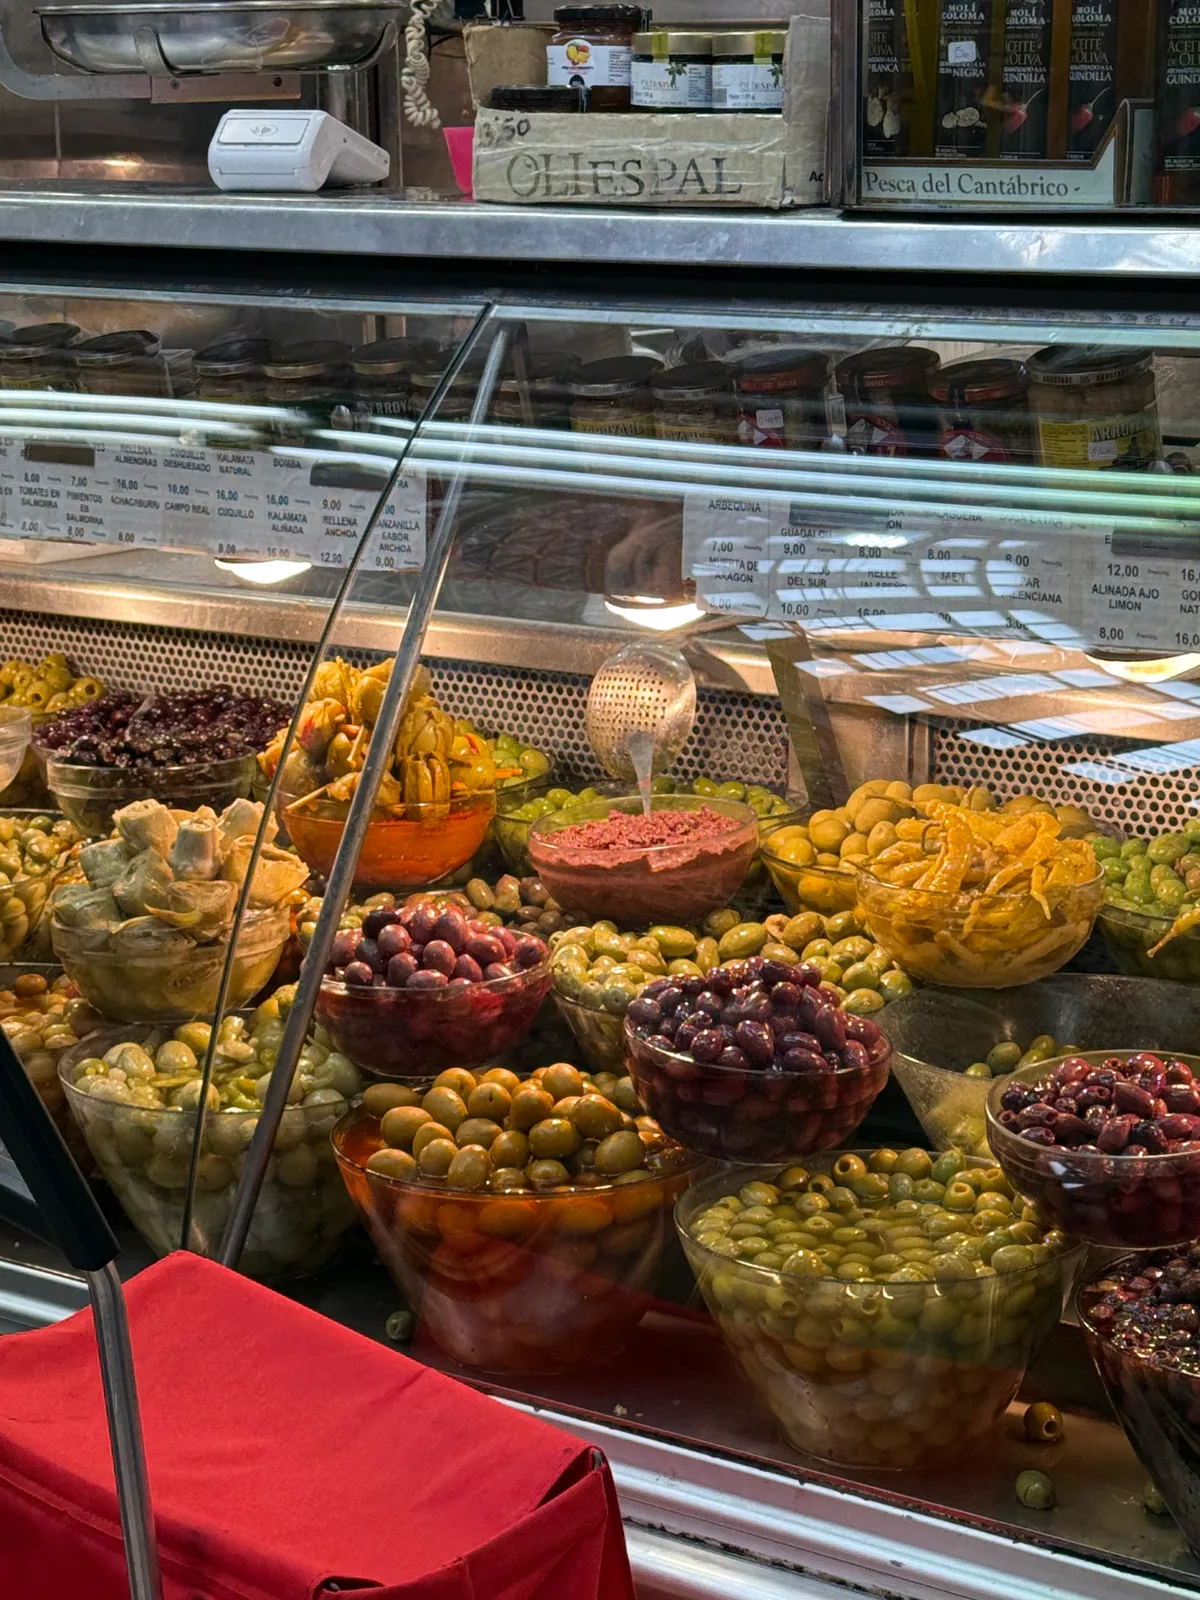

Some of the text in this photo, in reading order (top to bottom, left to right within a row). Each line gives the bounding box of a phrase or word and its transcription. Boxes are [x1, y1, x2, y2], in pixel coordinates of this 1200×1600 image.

[942, 12, 985, 20] COLOMA
[1009, 52, 1043, 65] OLIVA
[1075, 51, 1109, 63] OLIVA
[952, 68, 984, 77] NEGRA
[1003, 73, 1045, 83] GUINDILLA
[1069, 71, 1112, 82] GUINDILLA
[507, 152, 742, 198] OLIESPAL
[864, 171, 1069, 198] Pesca del Cantábrico
[170, 448, 205, 461] CUQUILLO
[217, 452, 255, 465] KALAMATA
[115, 455, 158, 468] ALMENDRAS
[163, 459, 211, 473] DESHUESADO
[273, 457, 302, 470] BOMBA
[219, 465, 252, 477] NATURAL
[19, 486, 49, 498] TOMATES
[66, 490, 103, 504] PIMIENTOS
[216, 489, 239, 502] 16,00
[164, 501, 211, 516] CAMPO REAL
[708, 498, 762, 513] ARBEQUINA
[66, 512, 104, 526] SALMORRA
[217, 506, 255, 519] CUQUILLO
[268, 511, 308, 523] KALAMATA
[322, 515, 358, 527] RELLENA
[375, 519, 420, 531] ANZANILLA
[325, 528, 358, 539] ANCHOA
[381, 531, 410, 542] SABOR
[379, 543, 412, 554] ANCHOA
[711, 540, 734, 553] 7,00
[783, 542, 806, 556] 9,00
[747, 561, 759, 572] DE
[1107, 563, 1139, 578] 12,00
[787, 576, 827, 588] DEL SUR
[1138, 588, 1160, 600] AJO
[781, 602, 810, 616] 10,00
[1109, 599, 1142, 612] LIMON
[1099, 627, 1124, 641] 8,00
